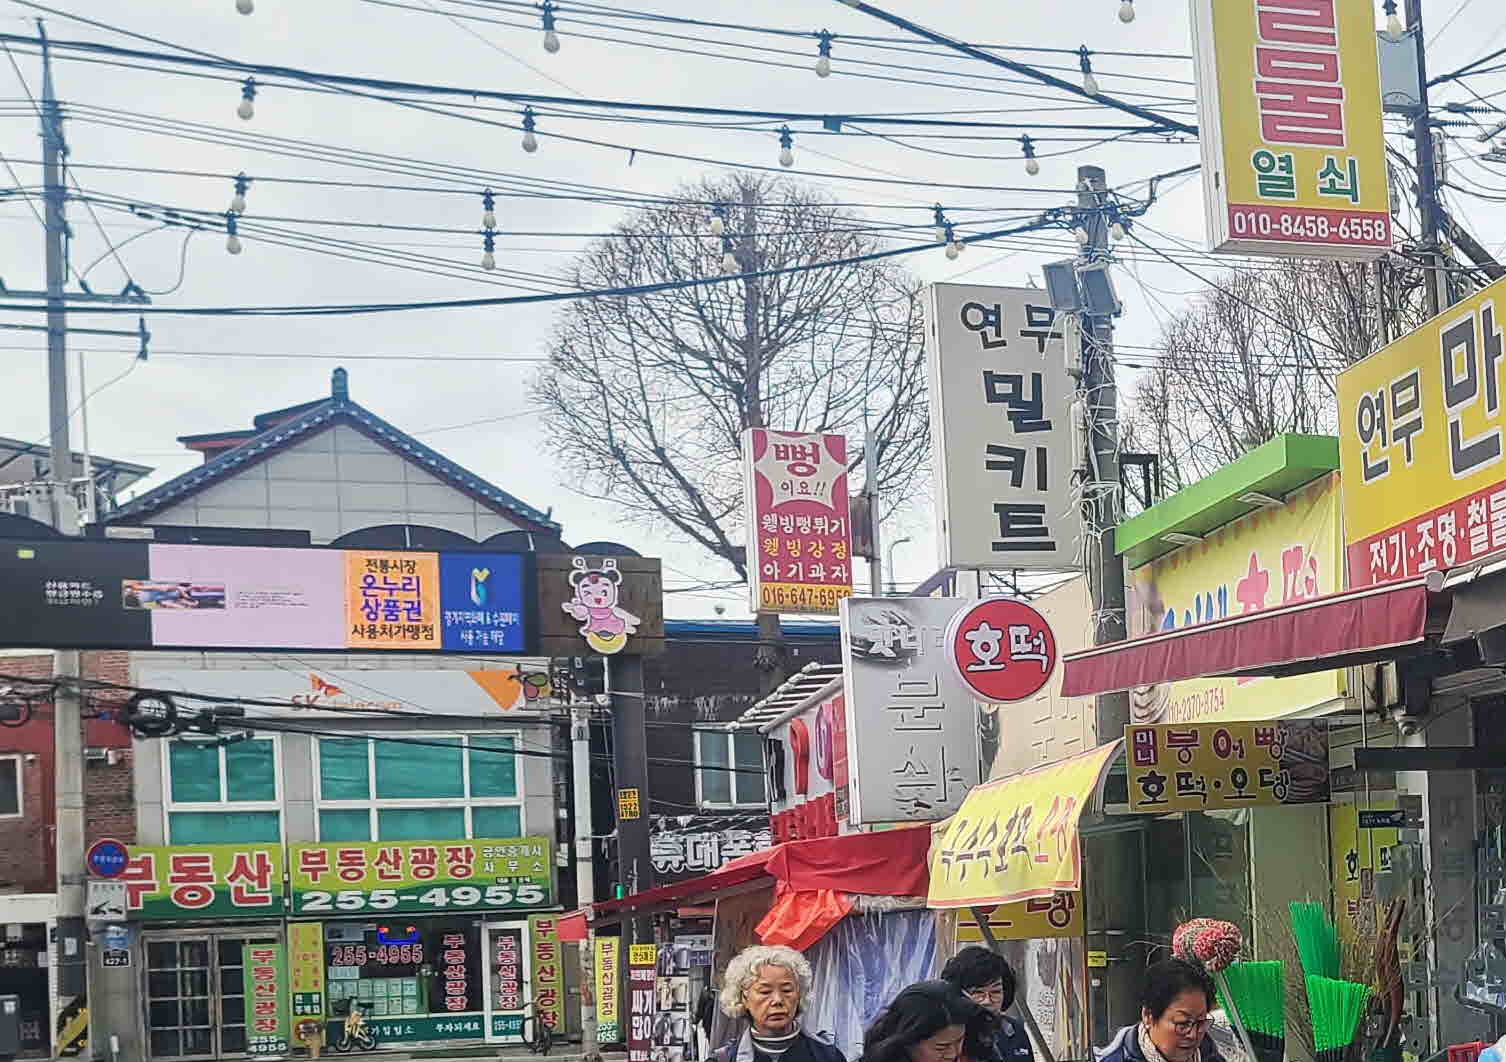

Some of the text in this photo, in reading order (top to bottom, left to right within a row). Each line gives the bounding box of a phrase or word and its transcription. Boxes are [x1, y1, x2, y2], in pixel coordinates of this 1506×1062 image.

[1252, 150, 1360, 203] 열쇠
[1233, 211, 1386, 241] 010-8458-6558
[960, 302, 1062, 353] 연무
[1357, 368, 1424, 485] 연무
[772, 442, 821, 477] 뻥
[983, 370, 1057, 552] 밀키트
[359, 574, 421, 599] 온누리
[365, 559, 417, 575] 전통시장
[352, 623, 435, 641] 사용처가맹점
[361, 599, 424, 622] 상품권
[963, 620, 1050, 674] 호떡
[117, 852, 273, 909] 부동산
[299, 845, 475, 883] 부동산광장
[301, 884, 546, 912] 255-4955
[331, 943, 425, 967] 255-4955
[443, 933, 467, 1012] 부동산광장
[497, 934, 519, 1011] 부동산광장
[535, 919, 559, 1030] 부동산광장
[251, 948, 279, 1034] 부동산광장
